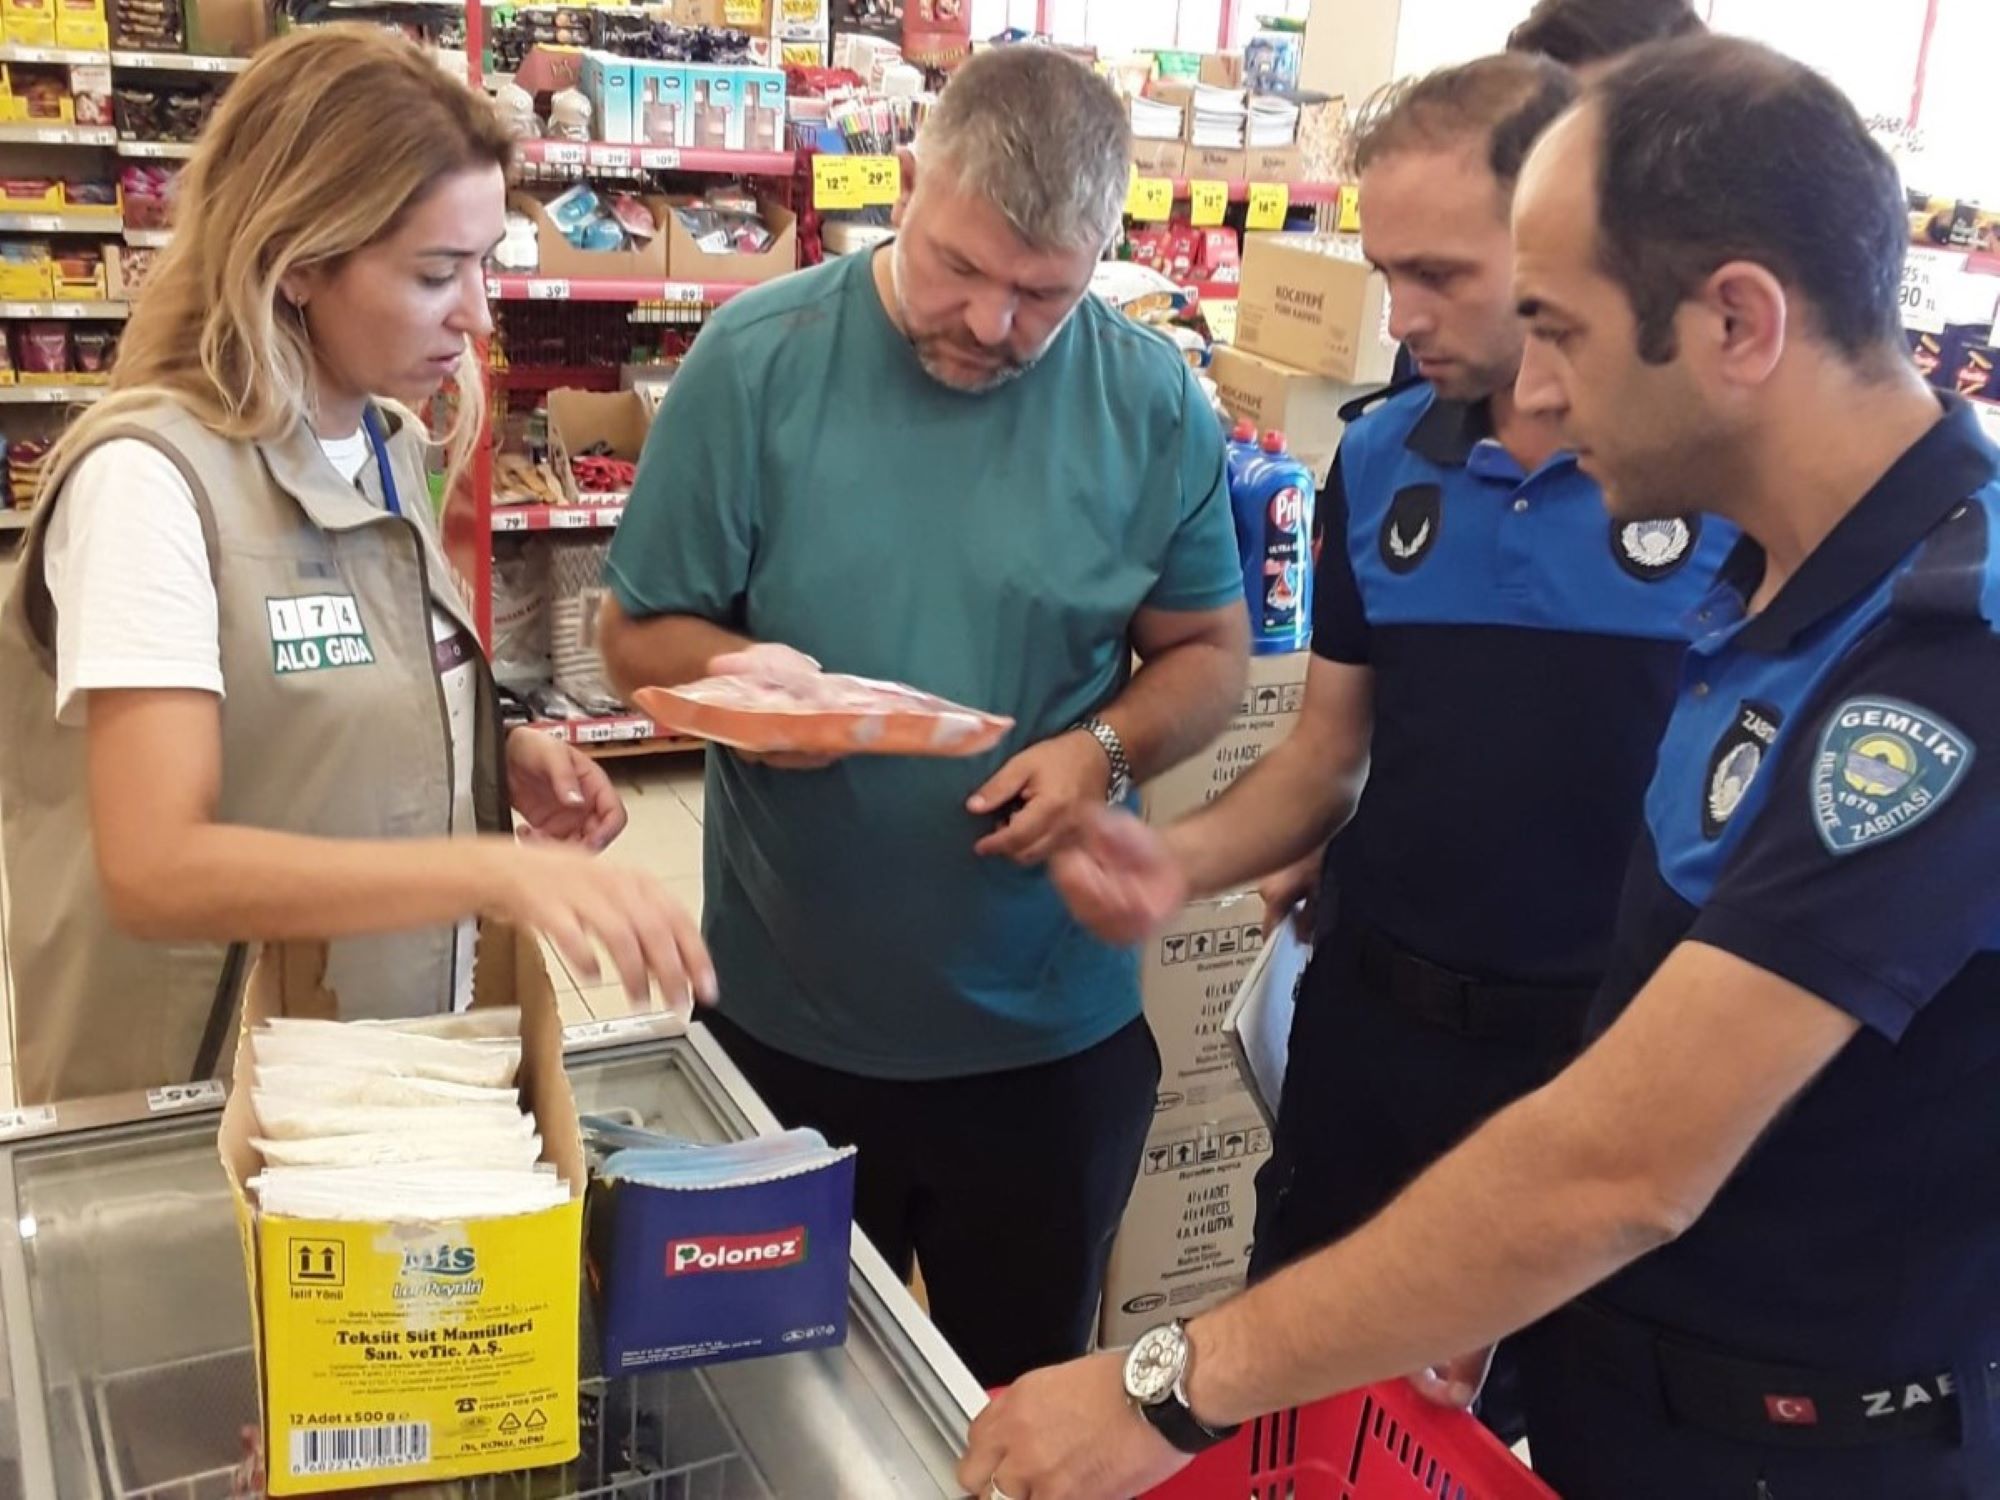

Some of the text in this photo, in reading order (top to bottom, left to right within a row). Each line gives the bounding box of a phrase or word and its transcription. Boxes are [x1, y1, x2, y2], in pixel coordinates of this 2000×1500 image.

[275, 638, 374, 672] ALO GIDA
[1840, 709, 1959, 766] GEMLİK
[1849, 786, 1934, 841] ZABITASI
[674, 1240, 796, 1271] Polonez
[337, 1319, 534, 1346] Teksüt Süt Mamülleri
[364, 1346, 402, 1361] San.
[467, 1340, 504, 1358] A.Ş.
[290, 1413, 304, 1425] 12
[307, 1412, 341, 1425] Adet
[354, 1411, 384, 1423] 500
